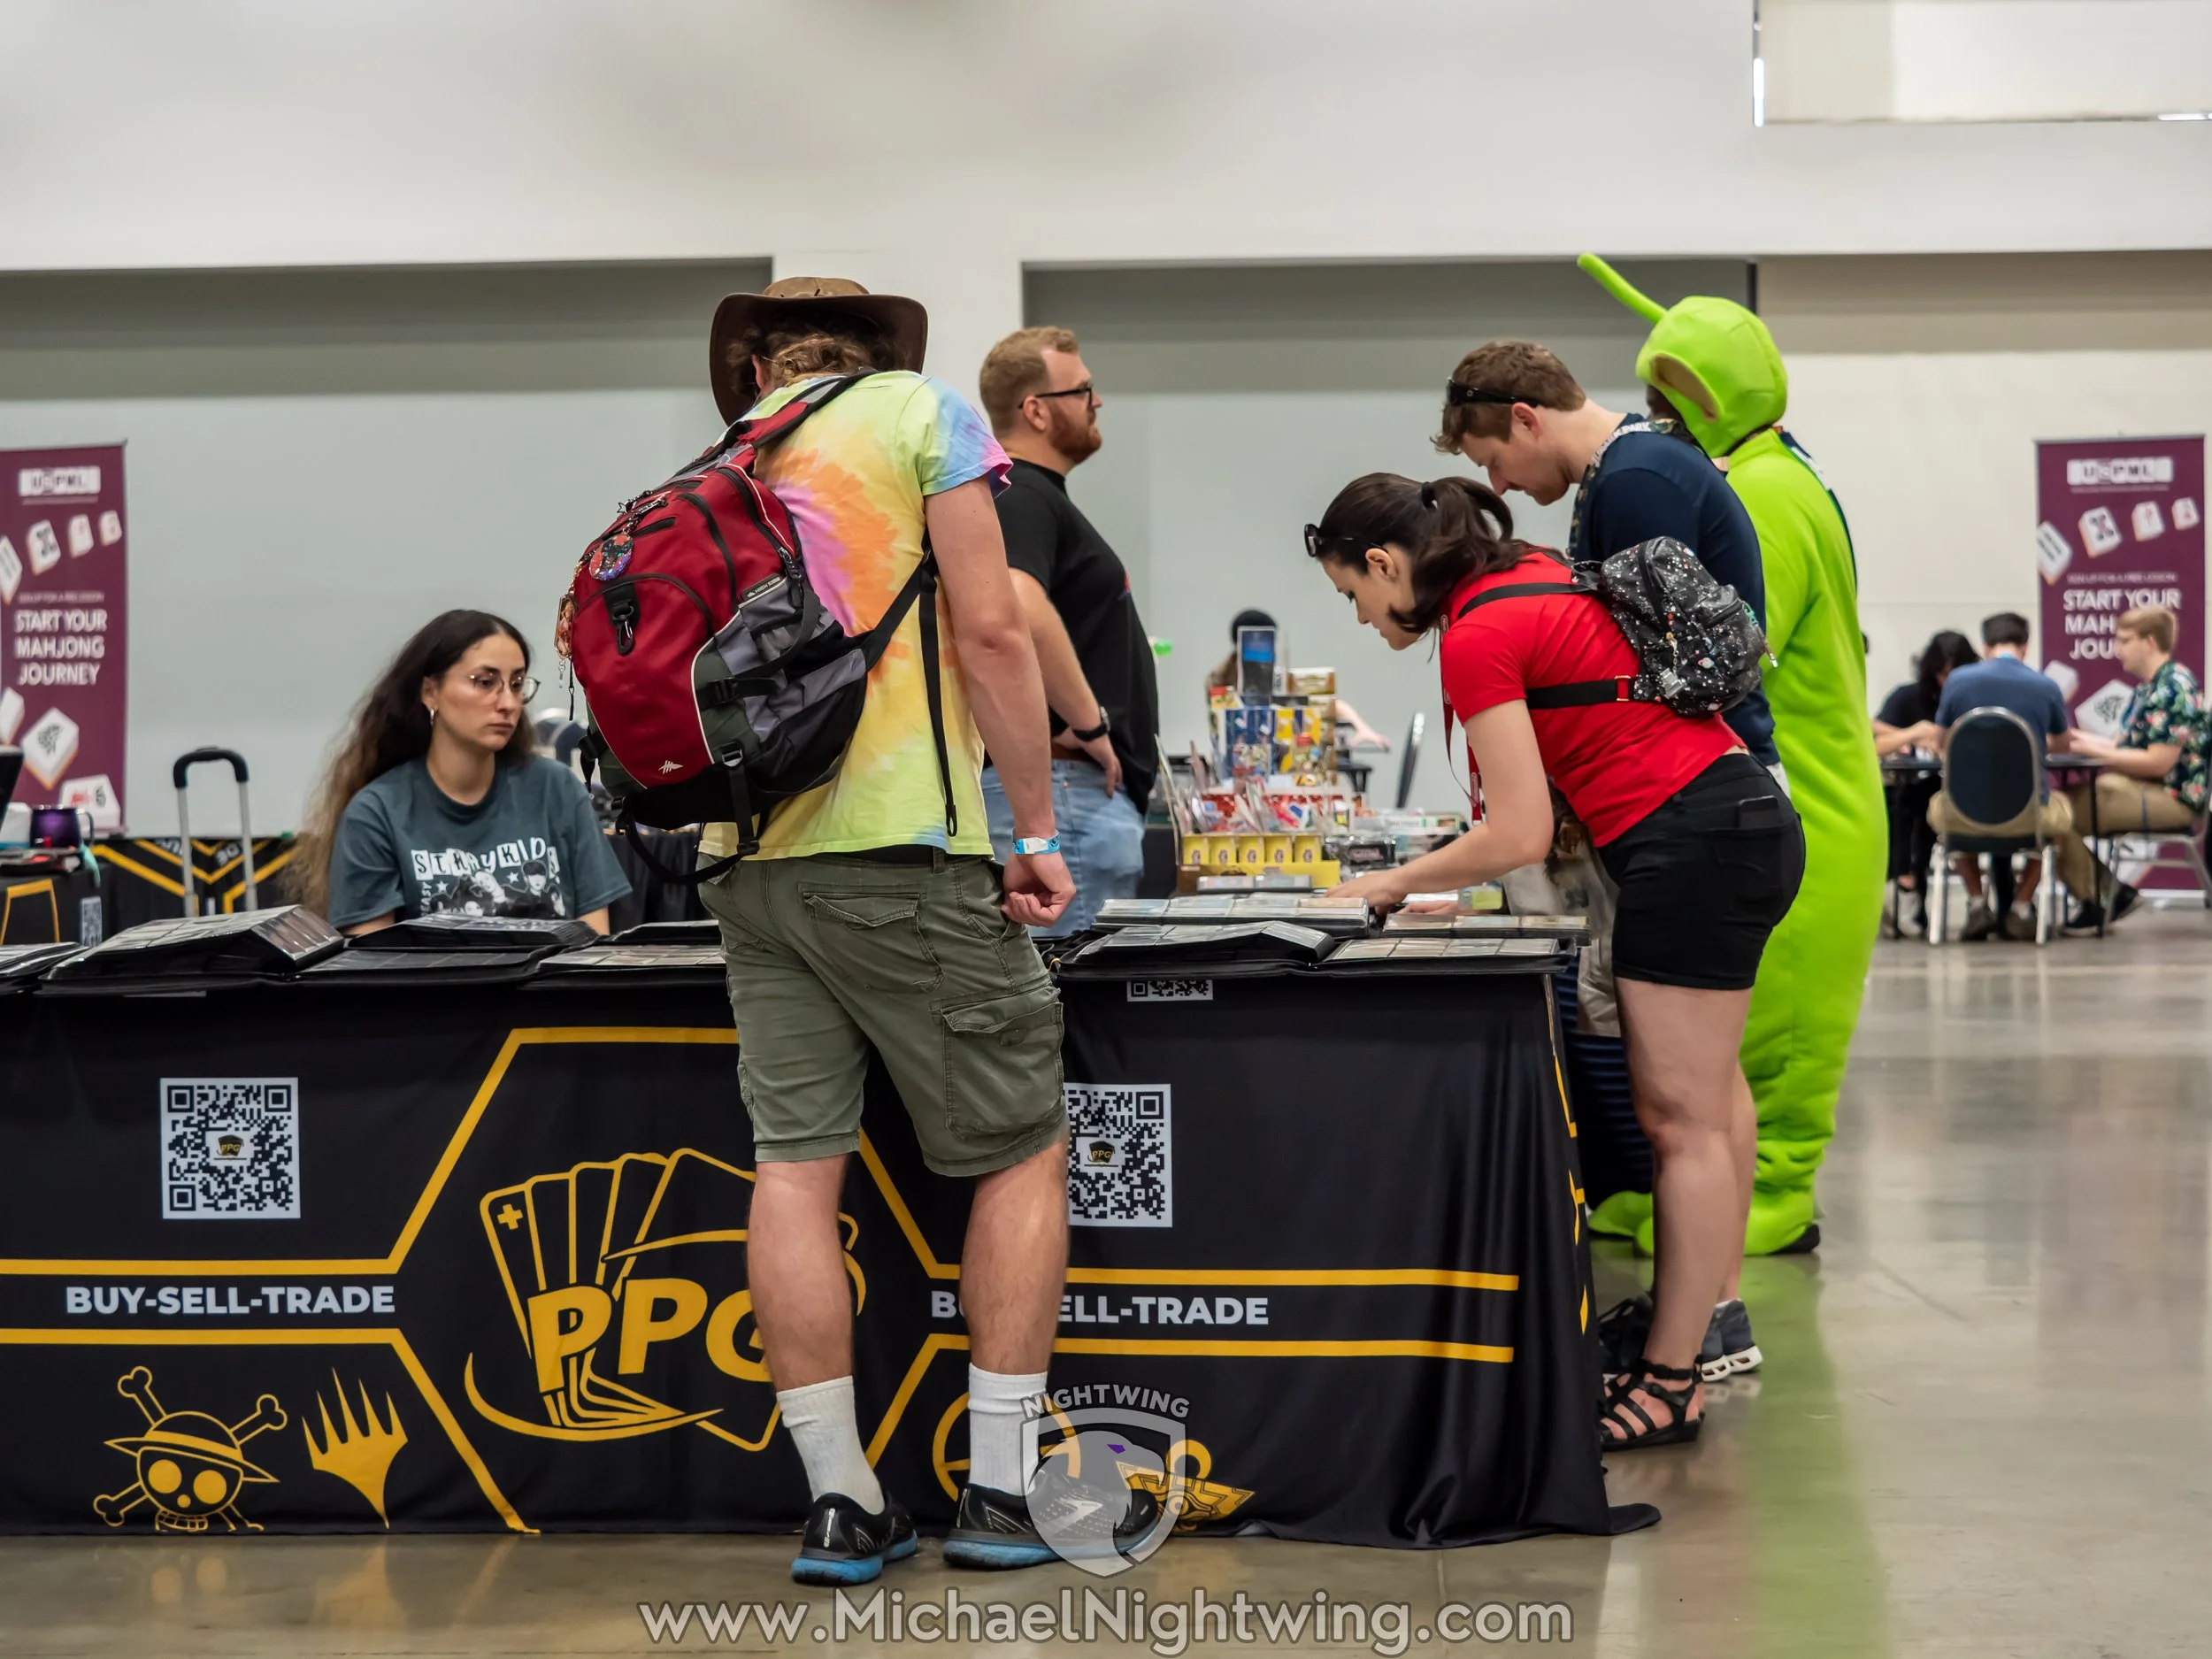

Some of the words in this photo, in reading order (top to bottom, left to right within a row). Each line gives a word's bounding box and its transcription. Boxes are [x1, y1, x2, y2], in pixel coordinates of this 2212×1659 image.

[2063, 588, 2122, 611] START
[2124, 588, 2182, 610] YOUR
[15, 609, 63, 632] START
[64, 608, 107, 632] YOUR
[16, 635, 104, 658] MAHJONG
[19, 662, 100, 685] JOURNEY
[1093, 1150, 1111, 1159] PPG
[65, 1286, 396, 1315] BUY-SELL-TRADE
[931, 1290, 1269, 1325] BELL-TRADE
